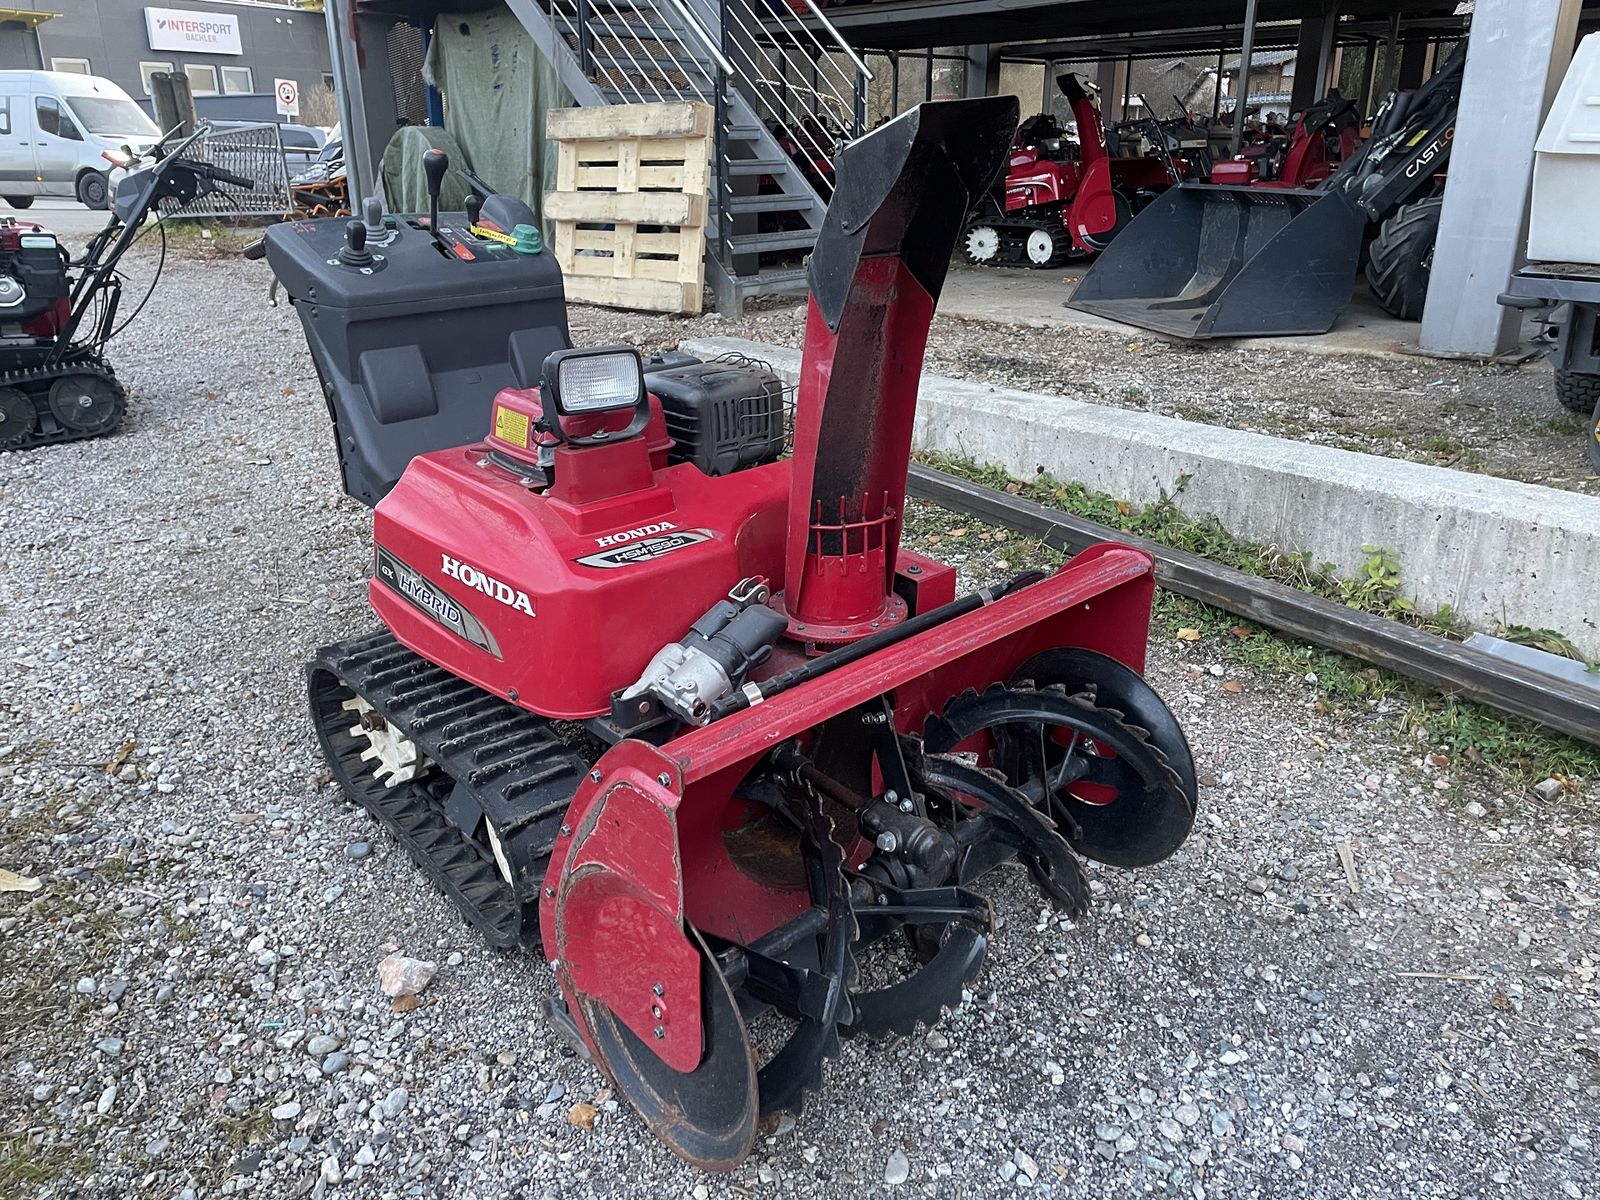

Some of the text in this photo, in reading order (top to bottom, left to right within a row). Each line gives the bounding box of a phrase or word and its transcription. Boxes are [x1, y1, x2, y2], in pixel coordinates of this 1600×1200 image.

[168, 19, 232, 35] INTERSPORT
[594, 521, 678, 548] HONDA
[614, 537, 685, 562] HSM1590i
[381, 565, 461, 626] GX HYBRID
[441, 553, 537, 618] HONDA
